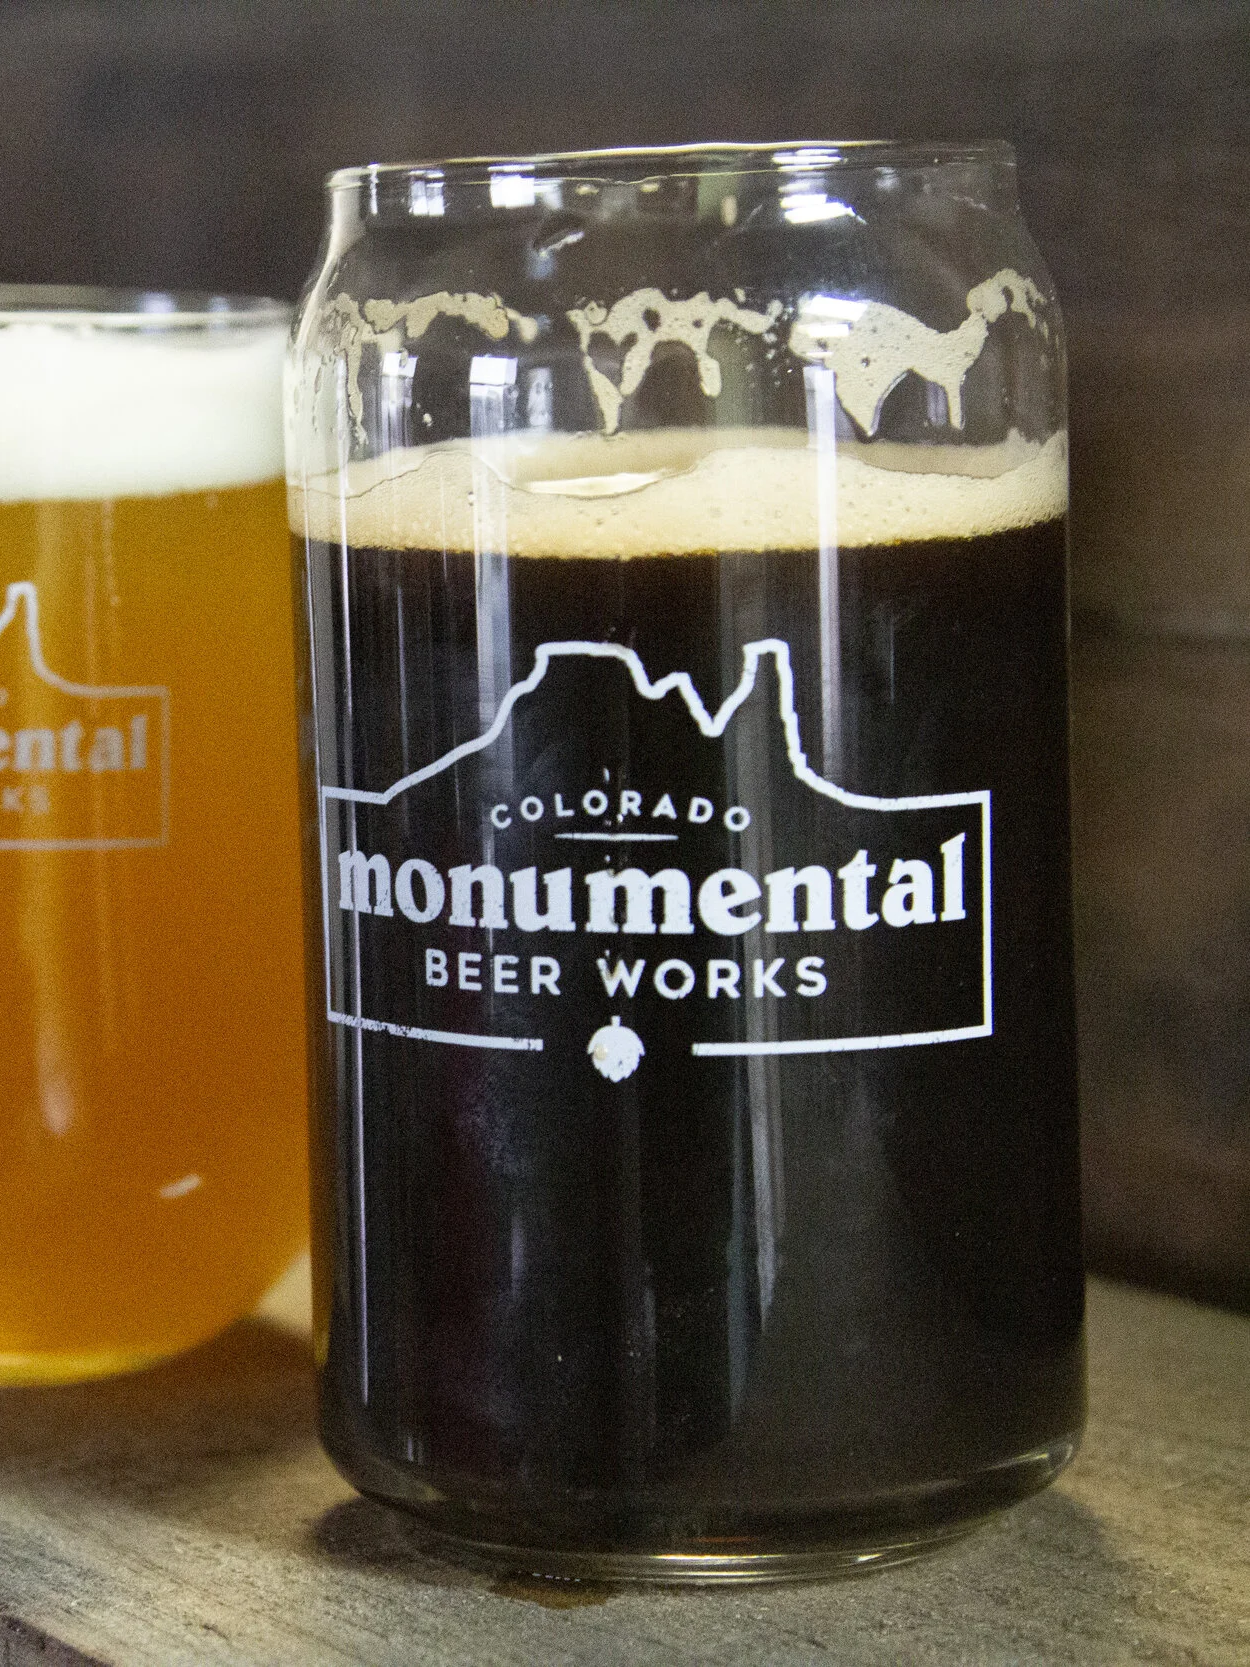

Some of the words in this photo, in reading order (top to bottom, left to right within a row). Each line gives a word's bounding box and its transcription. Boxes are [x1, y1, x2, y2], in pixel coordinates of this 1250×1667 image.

[491, 789, 751, 832] COLORADO
[338, 833, 966, 935] monumental
[425, 948, 561, 996] BEER
[598, 956, 827, 999] WORKS
